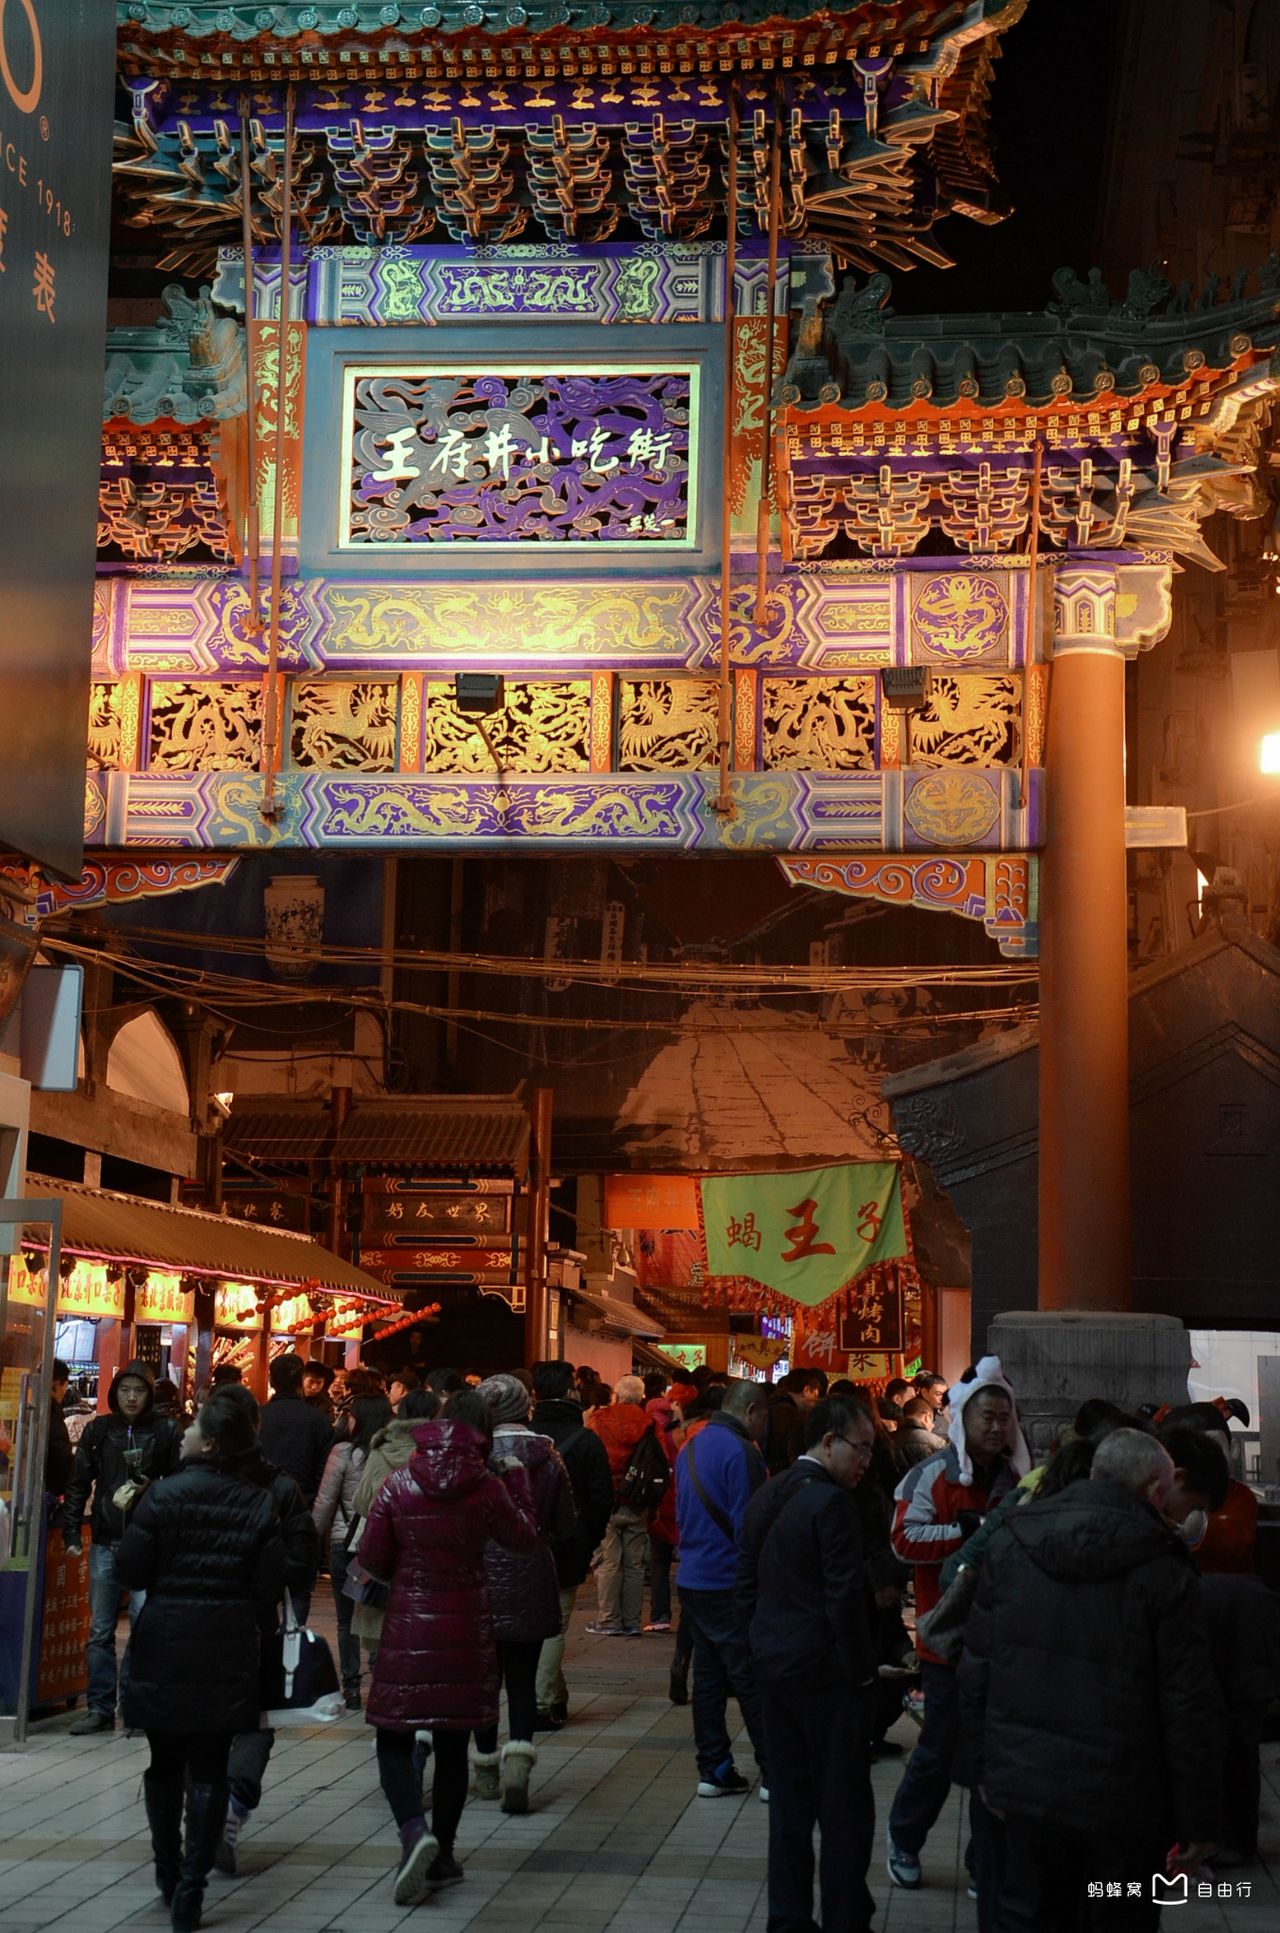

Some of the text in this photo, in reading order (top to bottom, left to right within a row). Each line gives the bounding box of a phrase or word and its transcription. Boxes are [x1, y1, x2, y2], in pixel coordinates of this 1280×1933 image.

[37, 179, 71, 237] 1918
[373, 423, 673, 482] 王府井小吃街
[385, 1202, 490, 1222] 好友世界
[725, 1198, 882, 1263] 蝎王子
